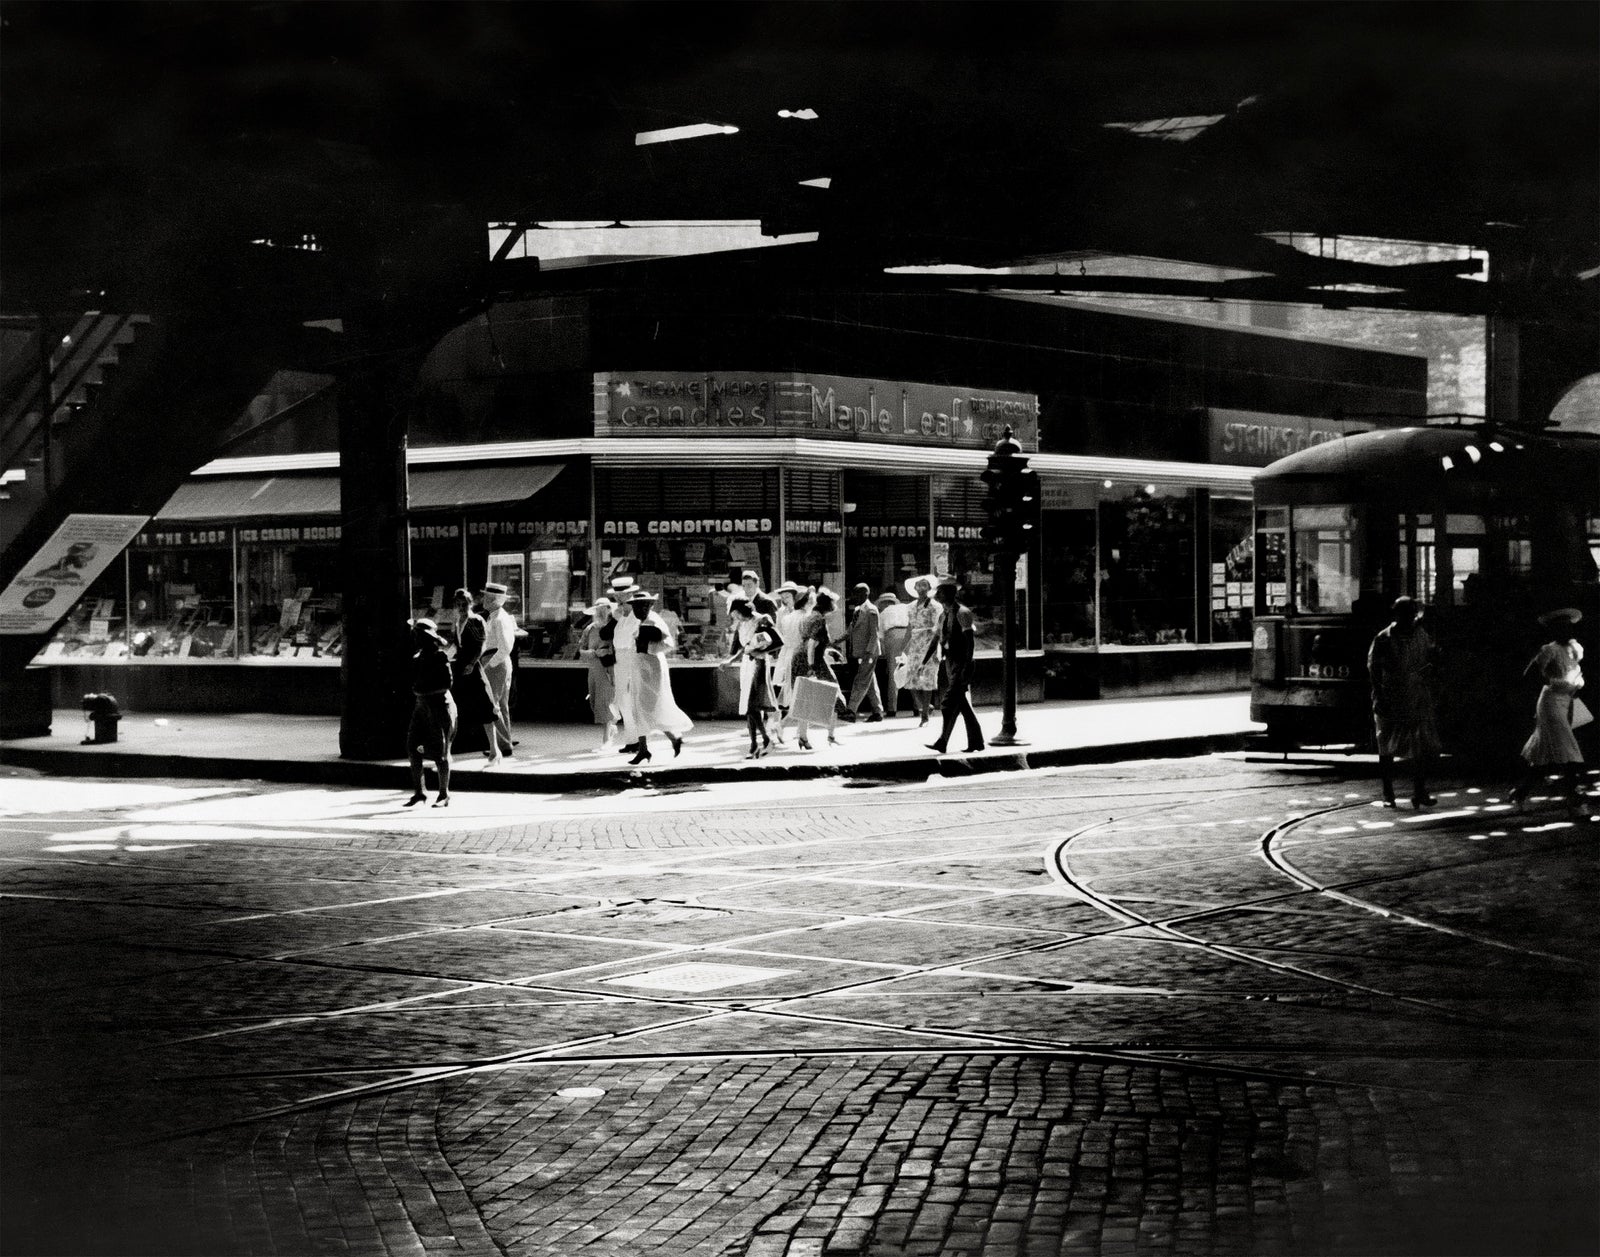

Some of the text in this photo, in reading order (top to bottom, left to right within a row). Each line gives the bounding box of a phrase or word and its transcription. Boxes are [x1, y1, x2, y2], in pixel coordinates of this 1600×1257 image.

[713, 381, 769, 396] MADE
[811, 386, 962, 441] Maple Leaf
[469, 520, 588, 535] EAT IN COMFORT
[603, 518, 772, 534] AIR CONDITIONED
[785, 520, 821, 533] SMARTEST
[862, 525, 927, 538] COMFORT
[936, 525, 956, 539] AIR
[156, 532, 182, 545] THE
[190, 530, 226, 545] LOOP
[239, 529, 258, 542] ICE
[261, 527, 300, 541] CREAM
